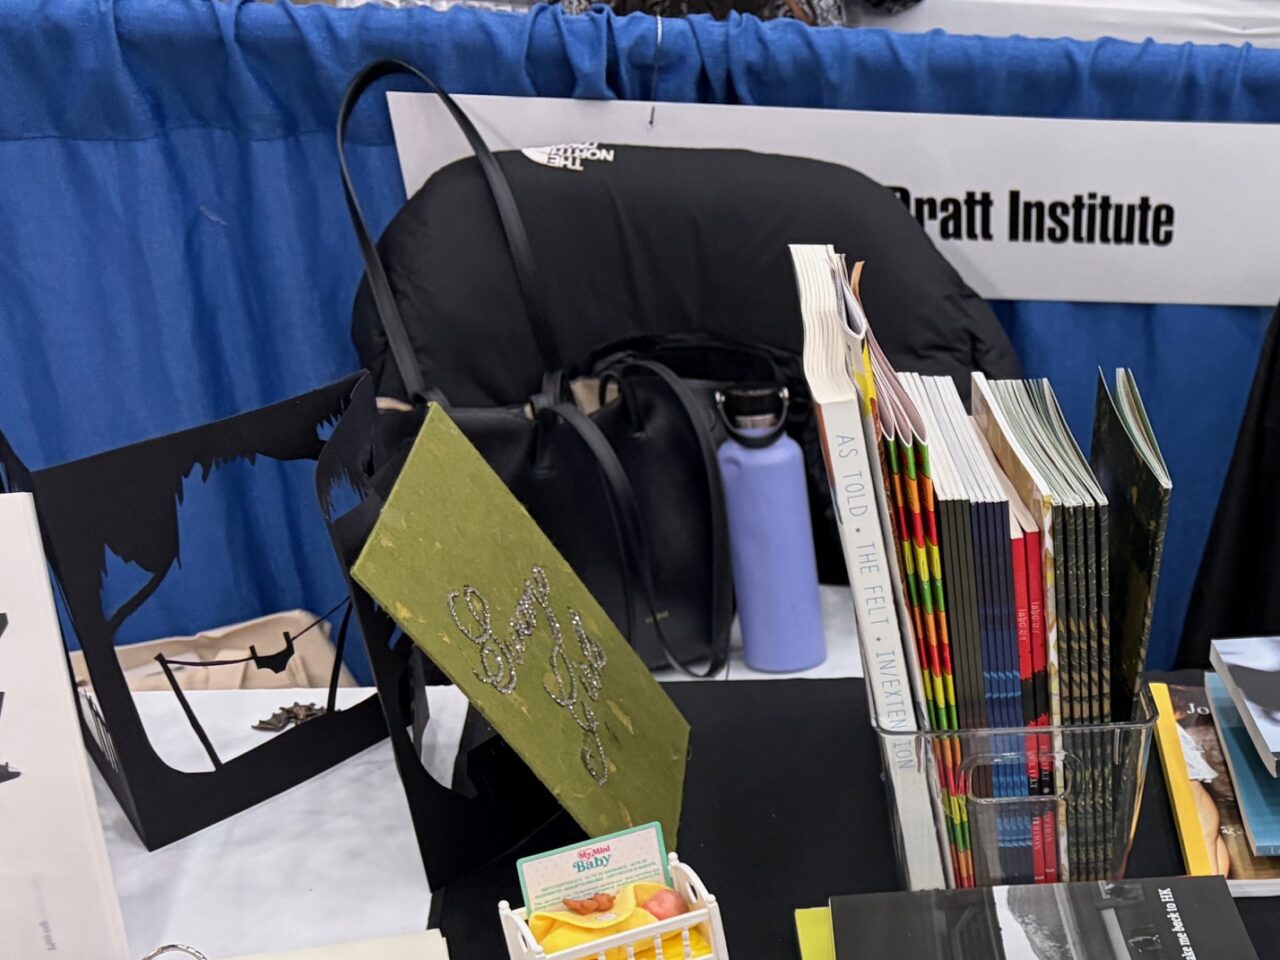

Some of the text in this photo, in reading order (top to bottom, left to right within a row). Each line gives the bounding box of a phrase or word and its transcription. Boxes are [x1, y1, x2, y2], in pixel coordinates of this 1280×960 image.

[1008, 190, 1175, 247] Institute
[835, 434, 916, 770] AS TOLD THE FELT IN/EXTENION
[573, 855, 611, 873] Baby
[1158, 887, 1174, 902] HK
[1166, 902, 1178, 912] to
[1167, 911, 1185, 932] back
[1177, 932, 1191, 946] me
